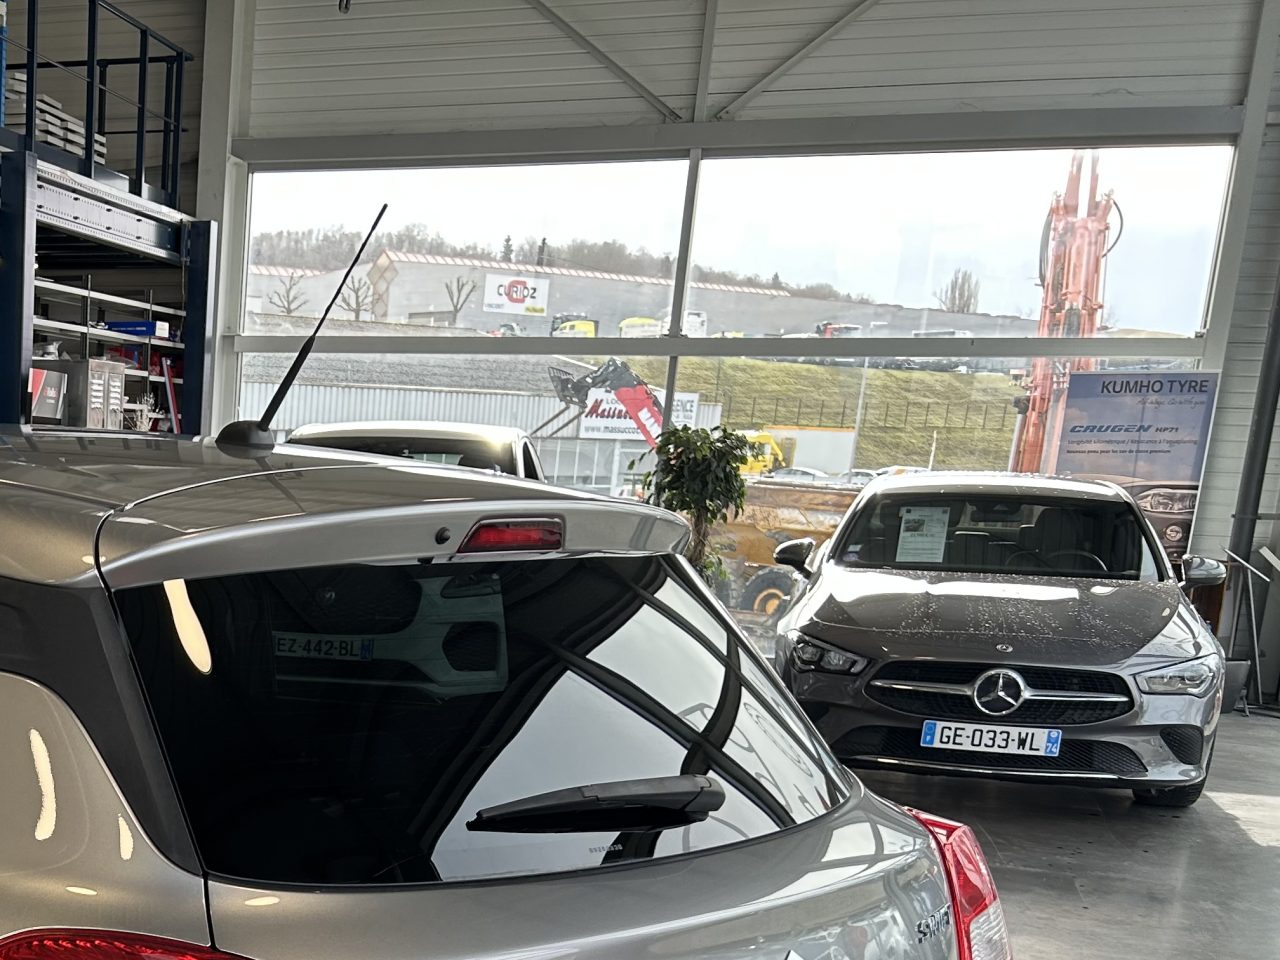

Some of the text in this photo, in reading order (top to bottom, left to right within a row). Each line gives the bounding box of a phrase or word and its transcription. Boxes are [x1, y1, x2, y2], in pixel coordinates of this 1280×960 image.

[497, 284, 537, 299] CURIOZ
[1100, 379, 1210, 394] KUMHO TYRE
[1069, 424, 1152, 433] CRUGEN
[276, 638, 360, 657] EZ-442-BL
[939, 726, 1040, 752] GE-033-WL
[1046, 743, 1058, 753] 74
